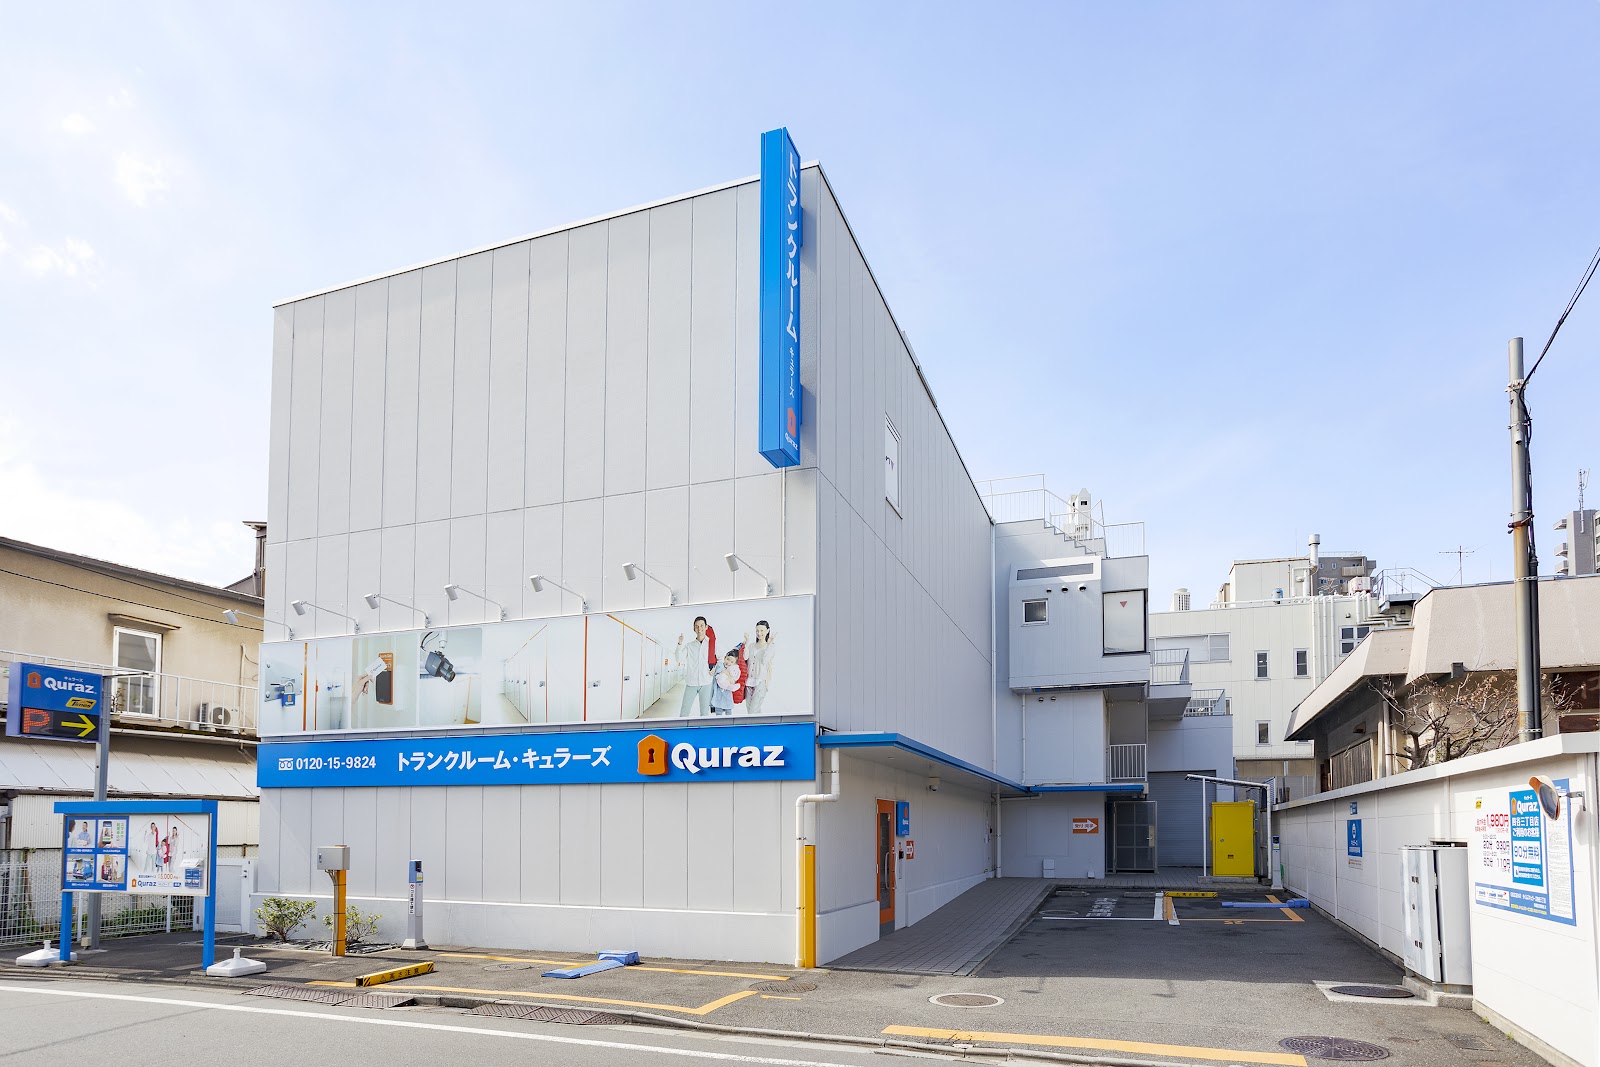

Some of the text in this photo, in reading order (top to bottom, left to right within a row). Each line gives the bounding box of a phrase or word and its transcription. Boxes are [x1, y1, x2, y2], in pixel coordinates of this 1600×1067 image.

[786, 151, 798, 343] トランクルーム
[44, 677, 94, 694] Quraz
[23, 708, 50, 734] P
[296, 742, 785, 774] 0120-15-9824 トランクルーム・キュラーズ Quraz
[1517, 800, 1539, 815] Quraz
[137, 880, 157, 888] Quraz
